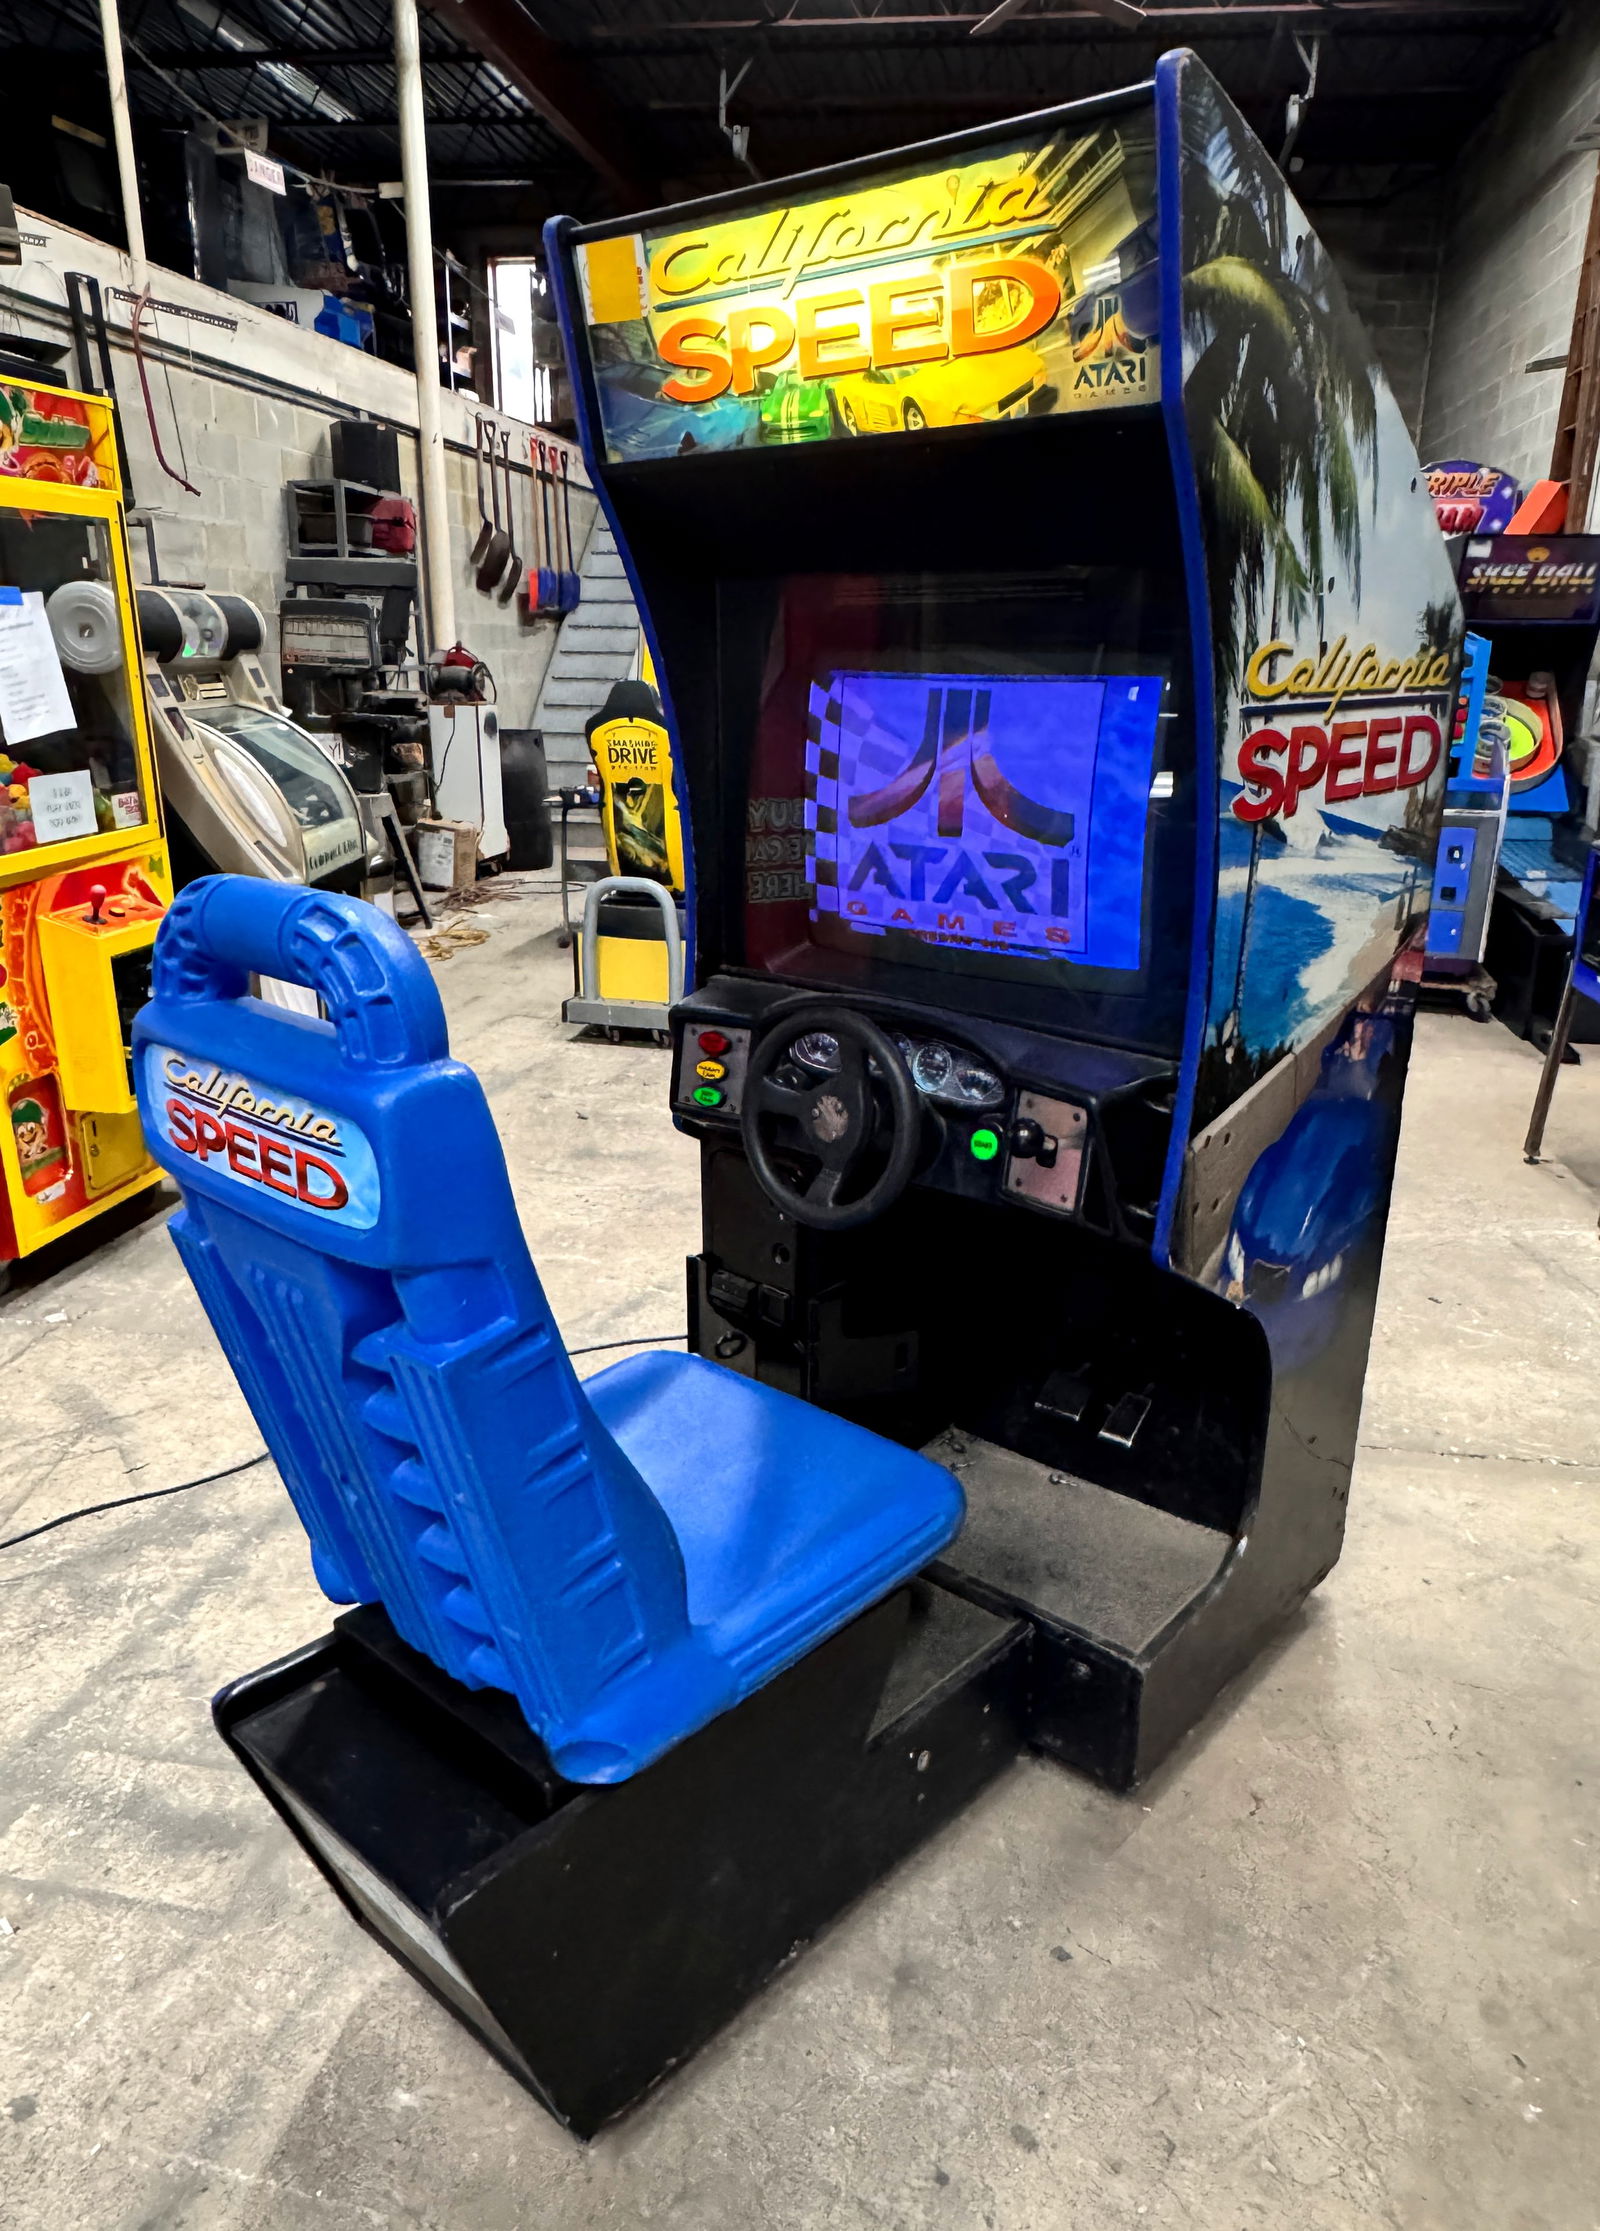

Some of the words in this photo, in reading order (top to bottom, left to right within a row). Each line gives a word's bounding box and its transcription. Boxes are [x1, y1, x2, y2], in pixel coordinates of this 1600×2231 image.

[651, 174, 1058, 299] California
[656, 259, 1062, 404] SPEED
[1073, 357, 1146, 390] ATARI
[1422, 471, 1502, 497] RIPLE
[1246, 634, 1452, 724] California
[607, 745, 658, 765] DRIVE
[1231, 715, 1442, 823] SPEED
[847, 840, 1070, 919] ATARI
[847, 900, 1072, 944] GAMES
[164, 1055, 343, 1147] California
[165, 1098, 349, 1211] SPEED
